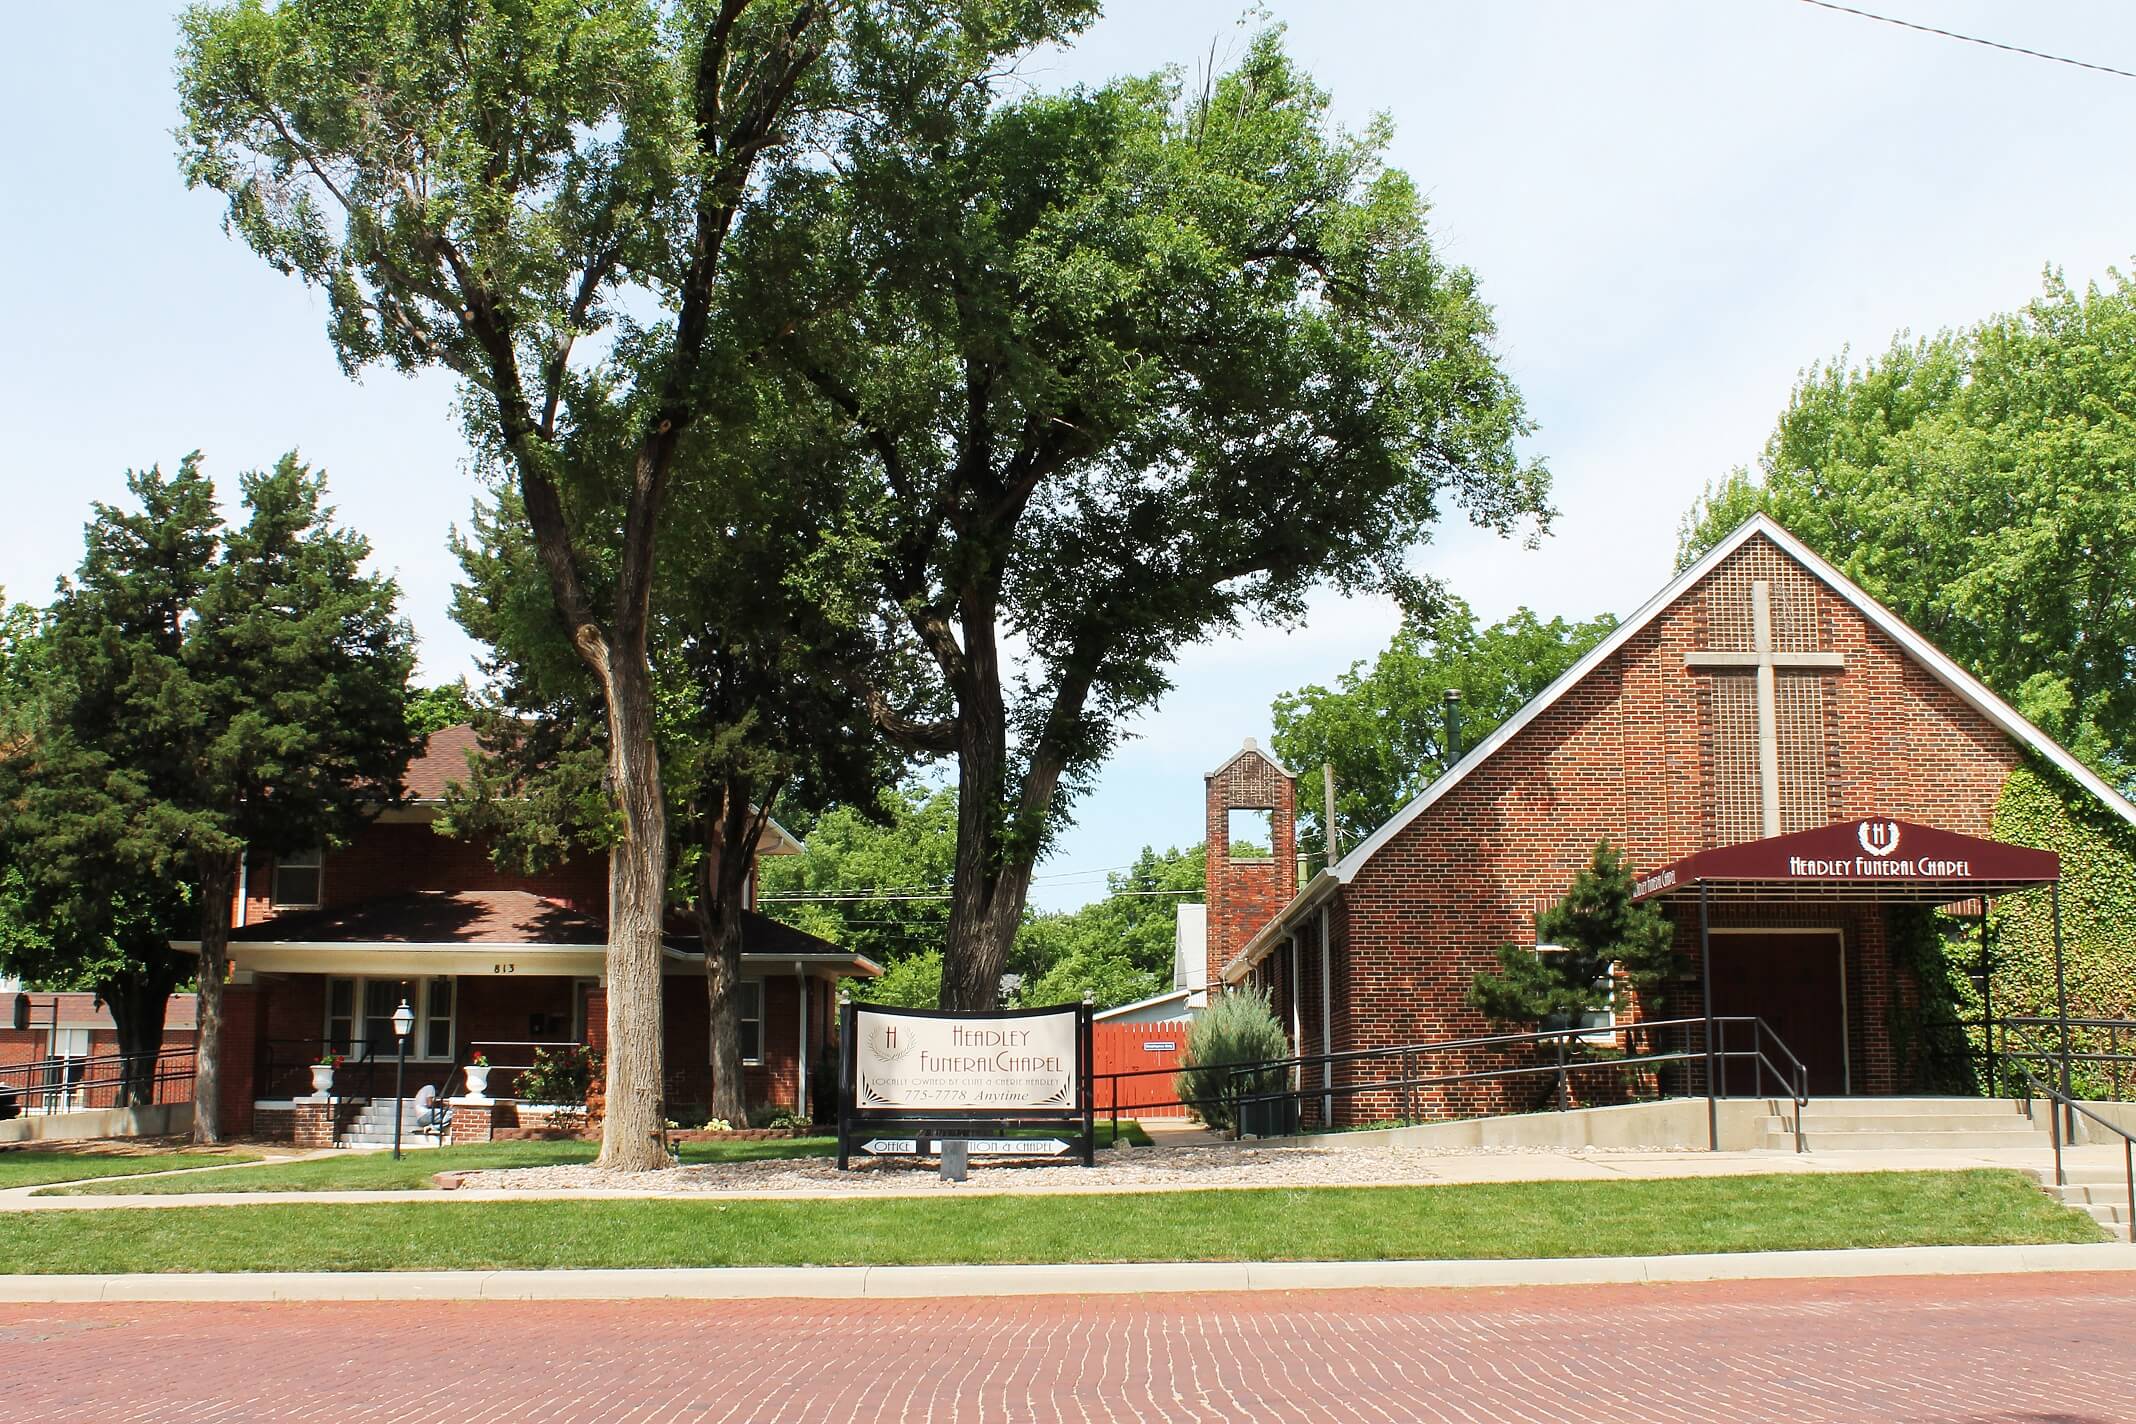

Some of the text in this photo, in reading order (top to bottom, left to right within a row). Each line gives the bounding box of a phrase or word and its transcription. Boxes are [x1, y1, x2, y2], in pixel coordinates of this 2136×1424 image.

[1872, 823, 1885, 845] H
[1789, 856, 1972, 876] HEADLEY FUNERAL CHAPEL
[494, 963, 515, 974] 813
[886, 1026, 897, 1049] H
[952, 1025, 1031, 1047] HEADLEY
[920, 1050, 1064, 1073] FUNERAL CHAPEL
[872, 1078, 908, 1087] LOCALLY
[911, 1078, 946, 1087] OWNED
[948, 1078, 959, 1087] BY
[1025, 1078, 1060, 1087] HEADLEY
[904, 1089, 1030, 1103] 775-7778 Anytime
[874, 1141, 911, 1152] OFFICE
[1015, 1141, 1054, 1152] CHAPEL
